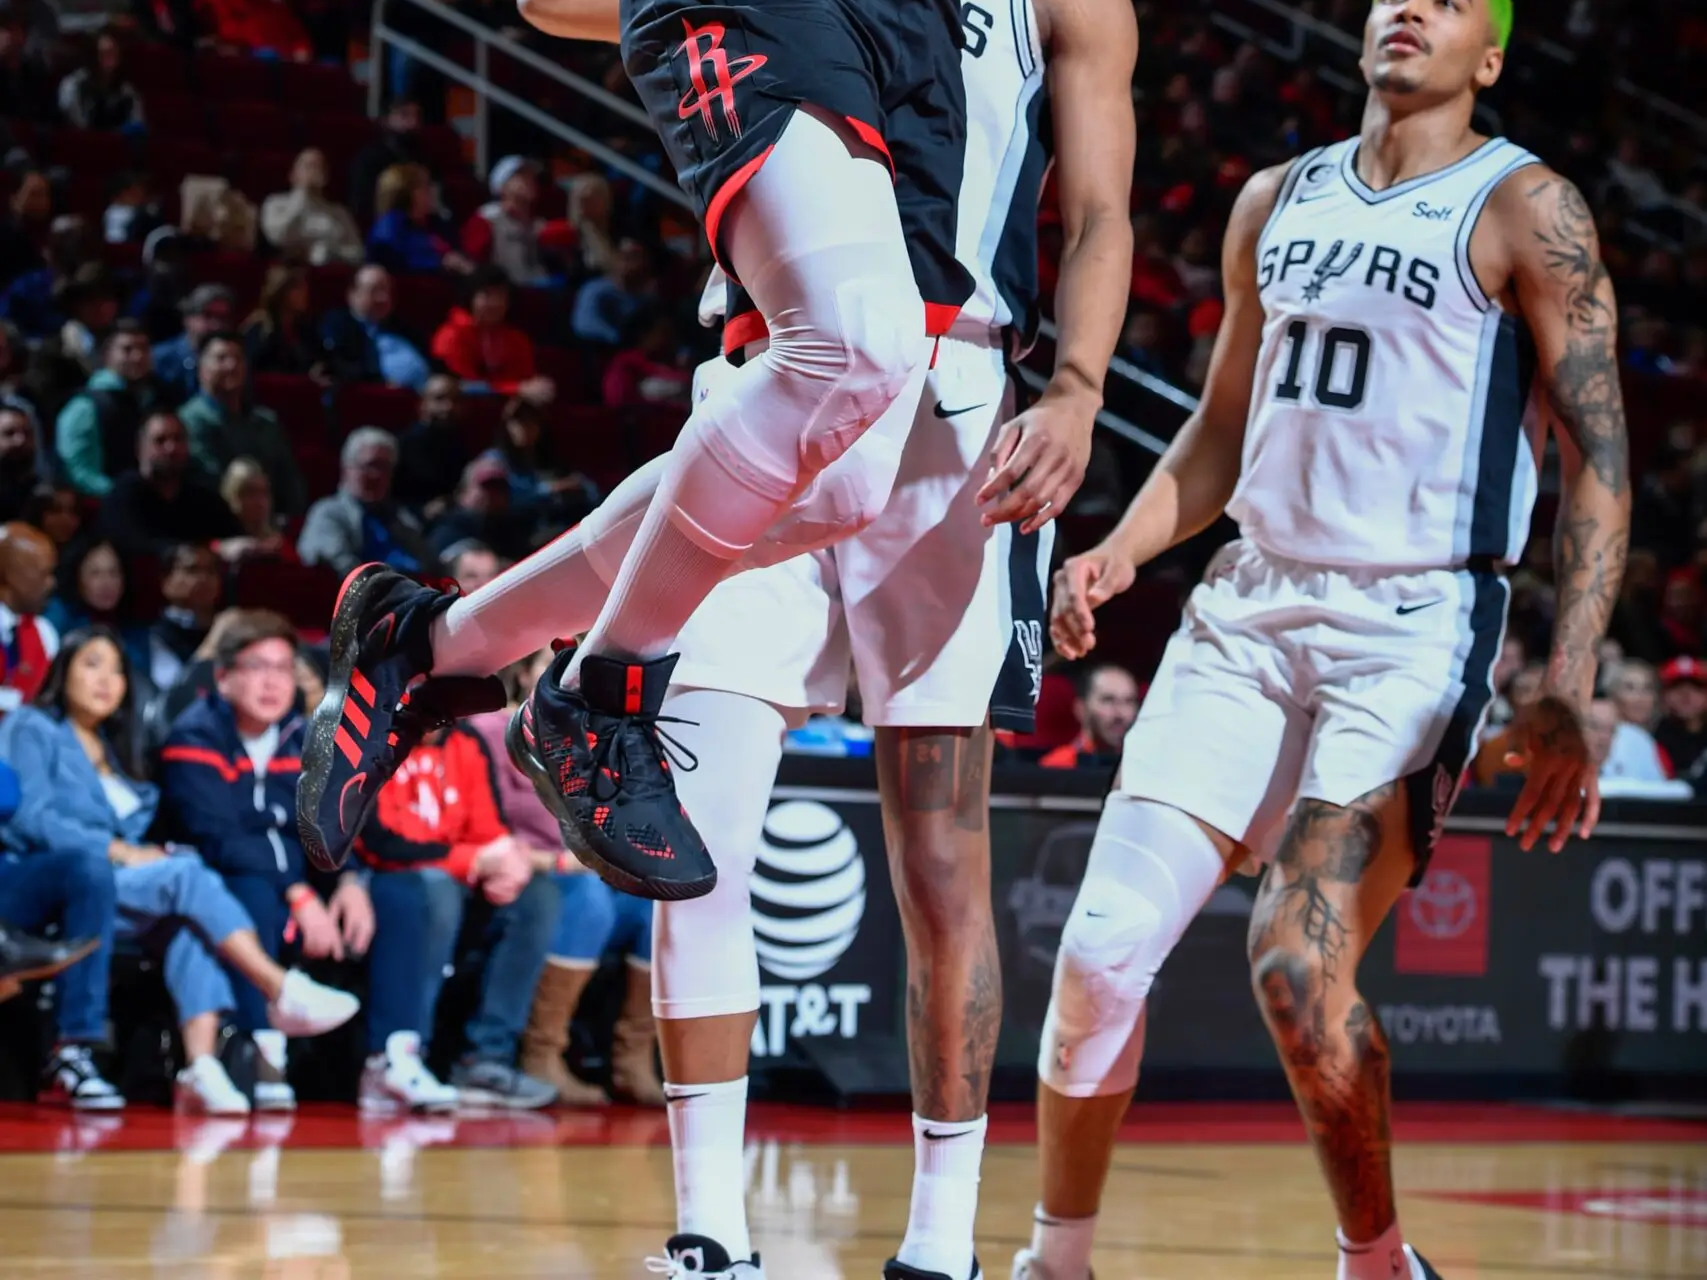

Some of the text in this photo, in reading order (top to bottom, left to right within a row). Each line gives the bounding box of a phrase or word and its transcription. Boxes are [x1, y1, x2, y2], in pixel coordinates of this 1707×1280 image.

[1259, 239, 1440, 310] SPURS
[1273, 319, 1374, 412] 10
[1377, 1004, 1502, 1045] TOYOTA
[1539, 955, 1659, 1031] THE
